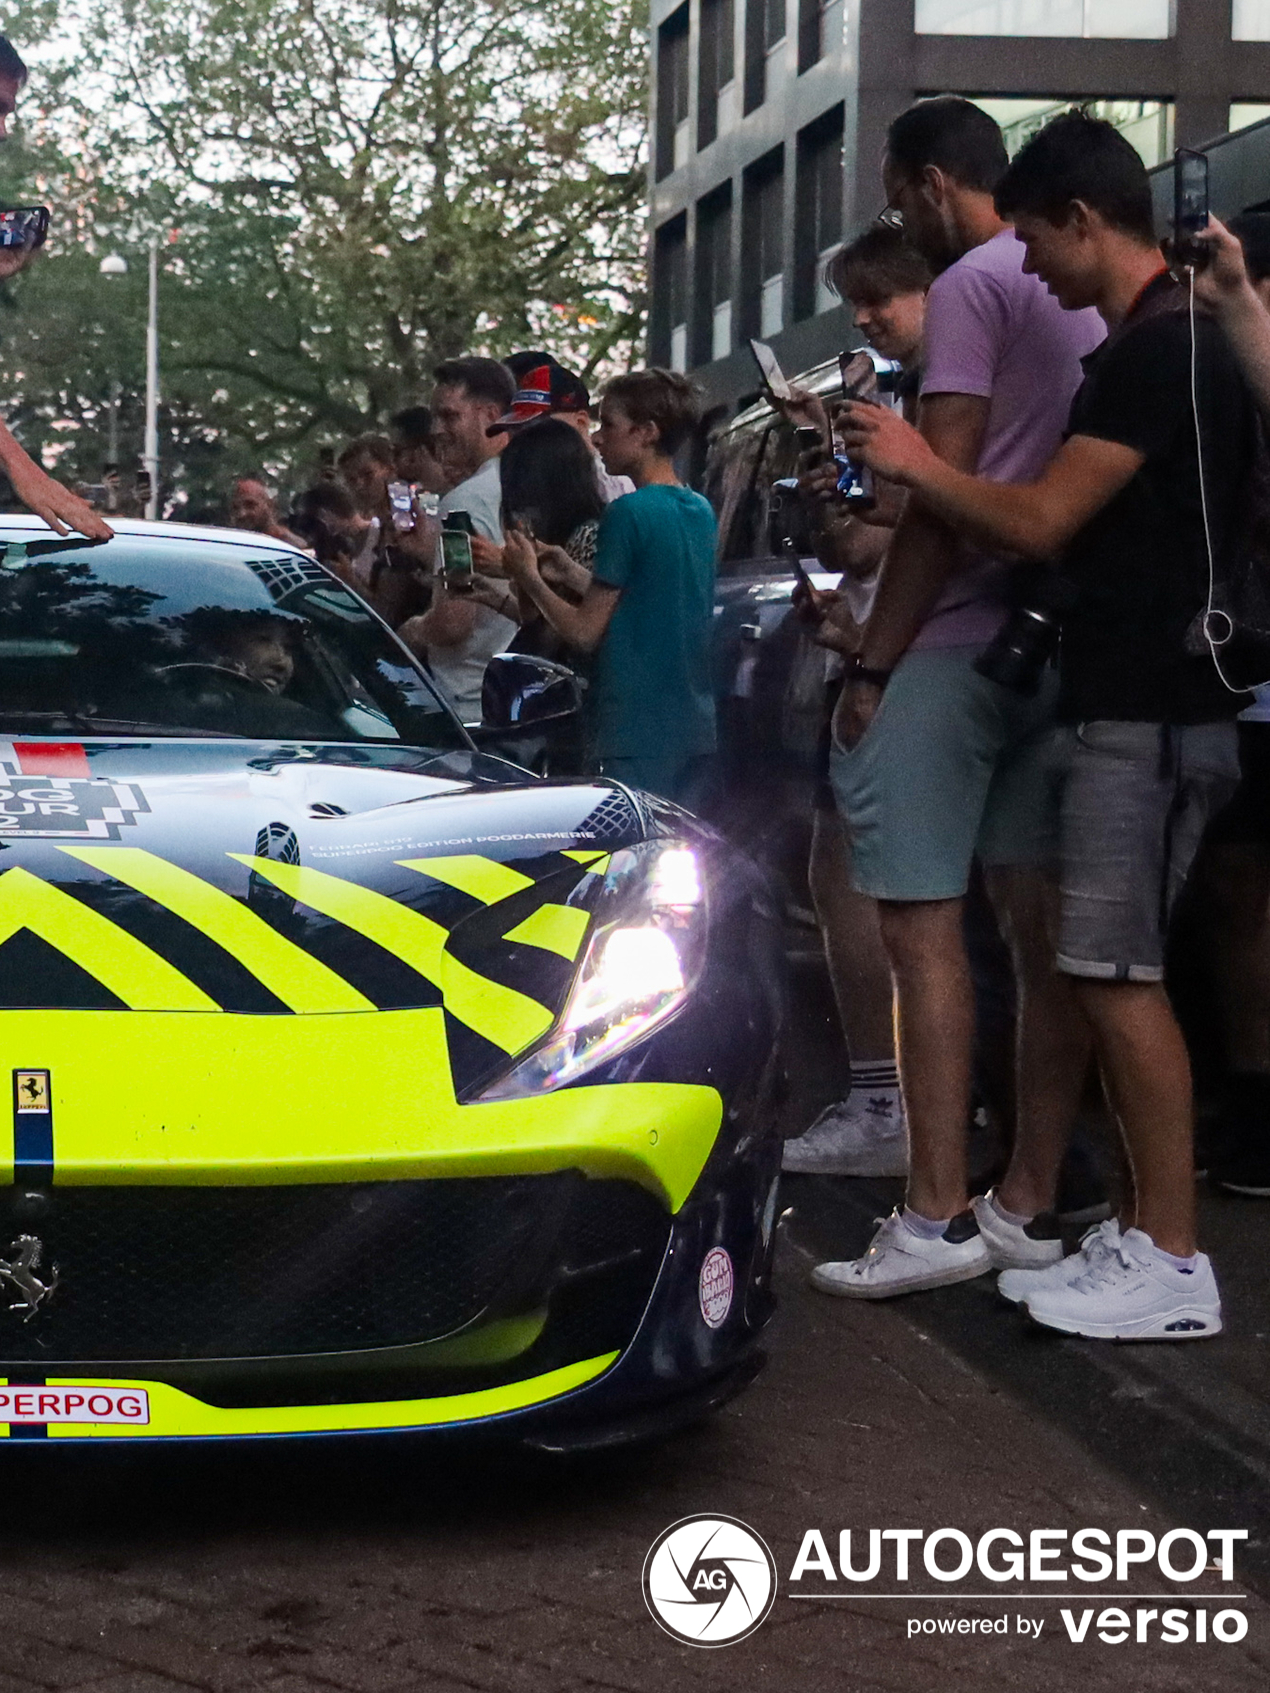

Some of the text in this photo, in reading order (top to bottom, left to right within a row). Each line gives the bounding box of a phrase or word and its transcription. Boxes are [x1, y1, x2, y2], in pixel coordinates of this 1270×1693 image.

[311, 831, 597, 859] SUPERPOG EDITION POGDARMERIE
[703, 1257, 728, 1282] GUM
